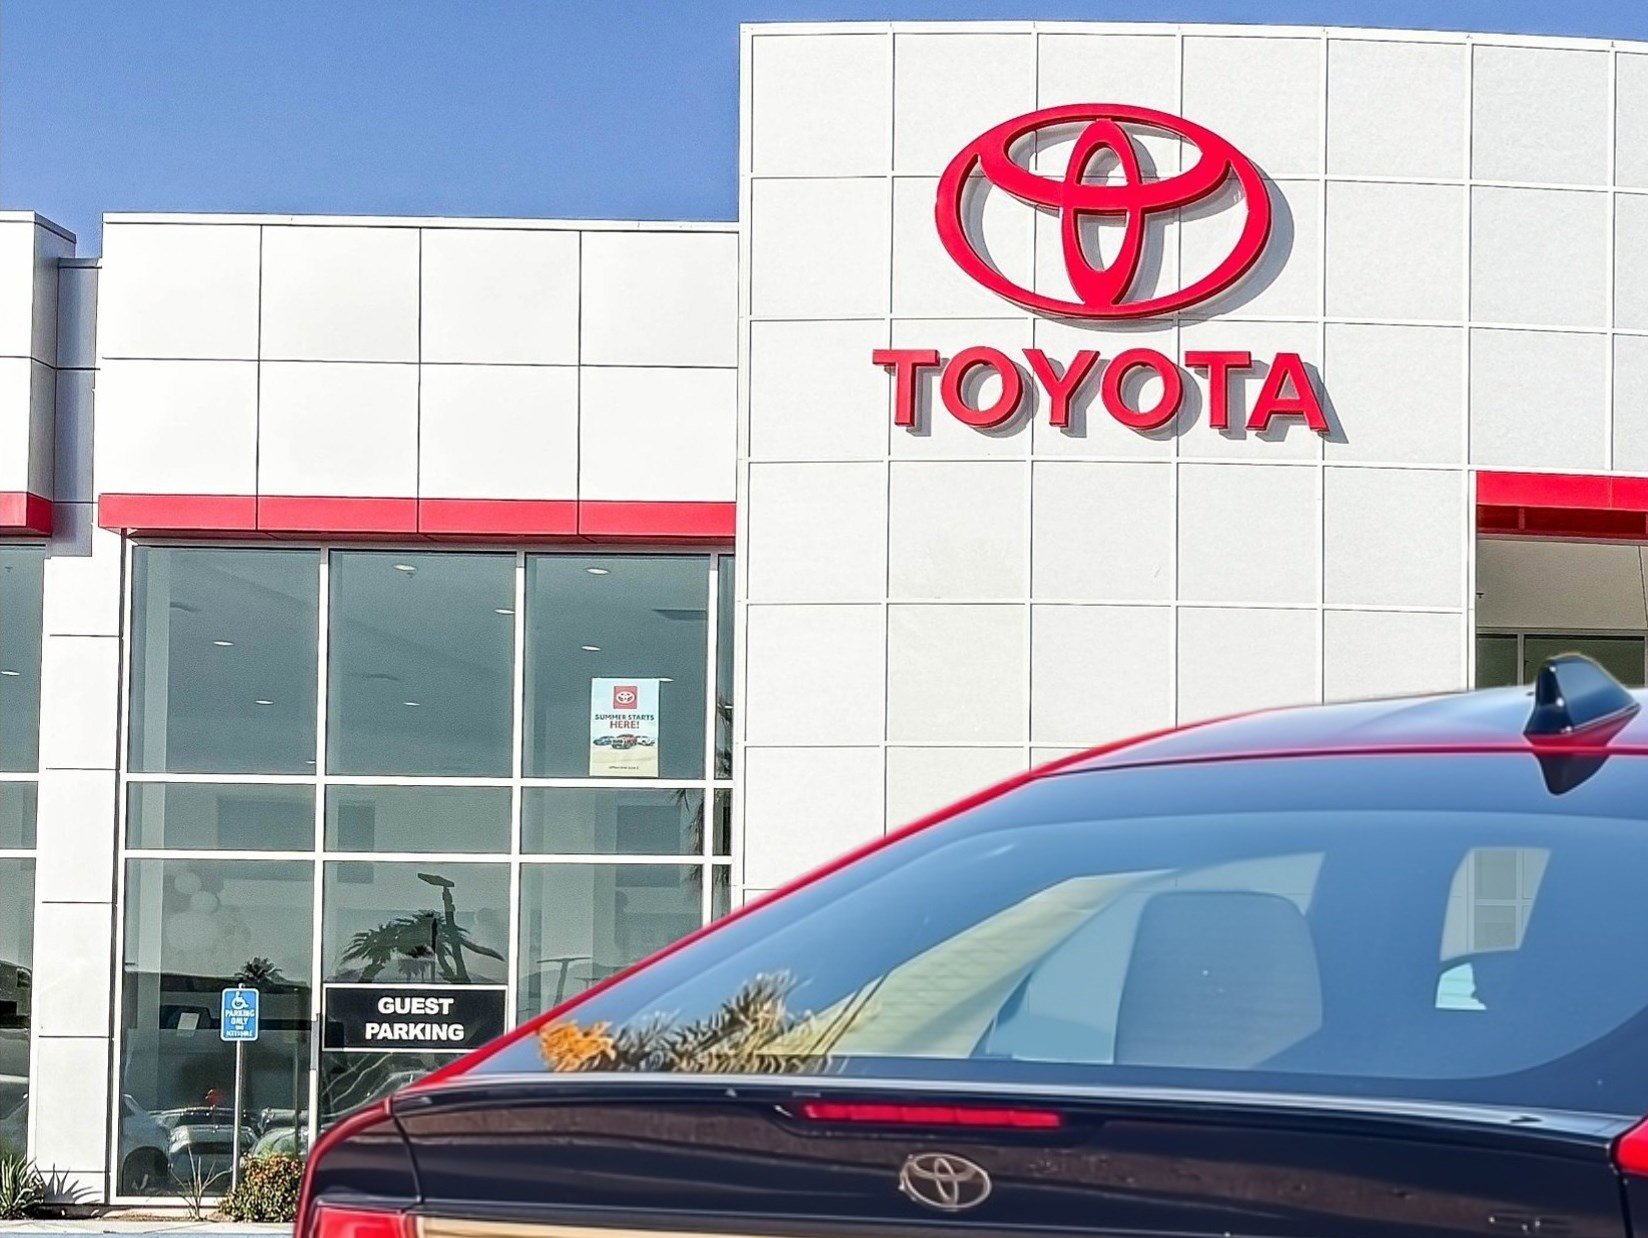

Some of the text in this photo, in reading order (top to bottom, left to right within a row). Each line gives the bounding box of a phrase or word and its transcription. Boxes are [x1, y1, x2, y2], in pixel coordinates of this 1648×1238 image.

[872, 346, 1329, 433] TOYOTA
[609, 720, 640, 729] HERE!
[377, 997, 454, 1015] GUEST
[365, 1022, 465, 1041] PARKING
